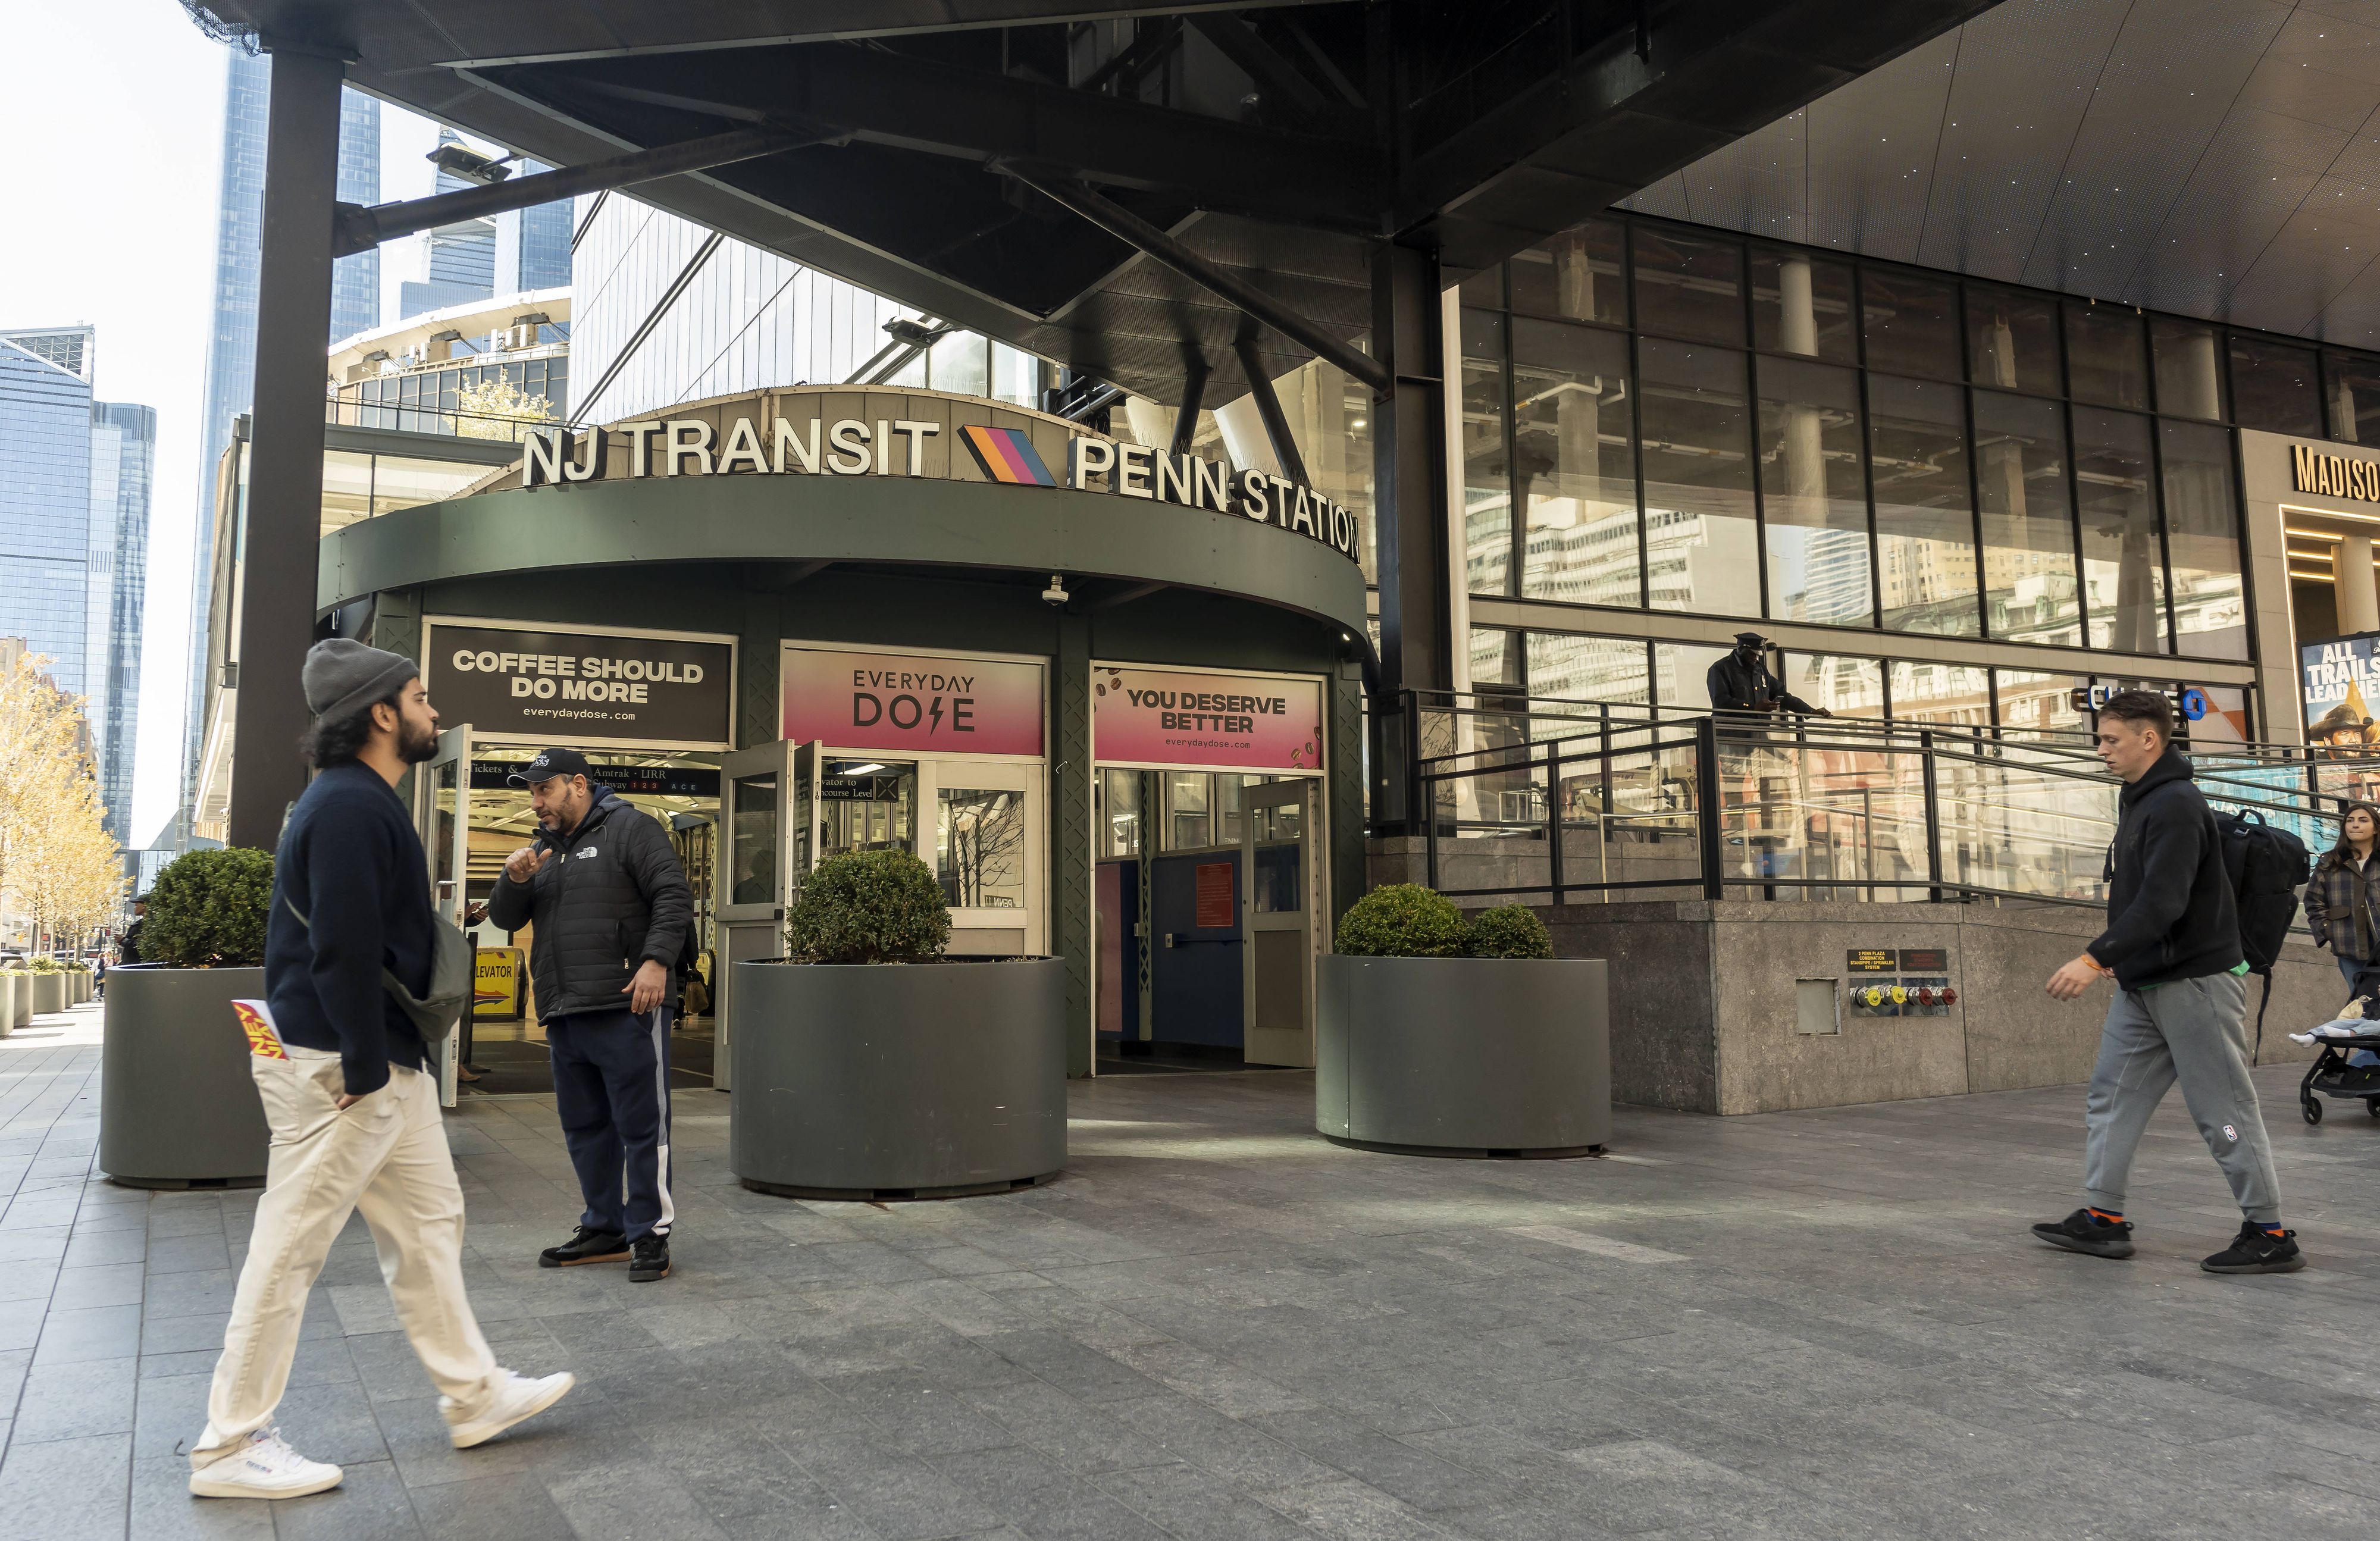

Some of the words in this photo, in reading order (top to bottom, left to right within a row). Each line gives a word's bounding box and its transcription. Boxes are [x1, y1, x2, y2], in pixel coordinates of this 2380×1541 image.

[2293, 444, 2380, 502] MADISO
[522, 425, 599, 486] NJ
[618, 417, 940, 477] TRANSIT
[1075, 436, 1227, 512] PENN
[1242, 469, 1361, 564] STATION
[2322, 642, 2357, 664] ALL
[452, 650, 576, 676] COFFEE
[581, 657, 703, 684] SHOULD
[2307, 657, 2380, 687] TRAILS
[511, 676, 556, 699] DO
[562, 679, 648, 704] MORE
[853, 670, 975, 693] EVERYDAY
[2353, 679, 2380, 700] HE
[1126, 689, 1176, 709] YOU
[1180, 692, 1286, 715] DESERVE
[2305, 682, 2349, 704] LEAD
[523, 707, 635, 721] everydaydose.com
[1161, 712, 1254, 734] BETTER
[1166, 738, 1251, 749] everydaydose.com
[594, 768, 630, 778] Amtrak
[641, 769, 666, 779] LIRR
[853, 788, 872, 798] Level
[476, 966, 512, 978] LEVATOR
[234, 1004, 270, 1054] NEY
